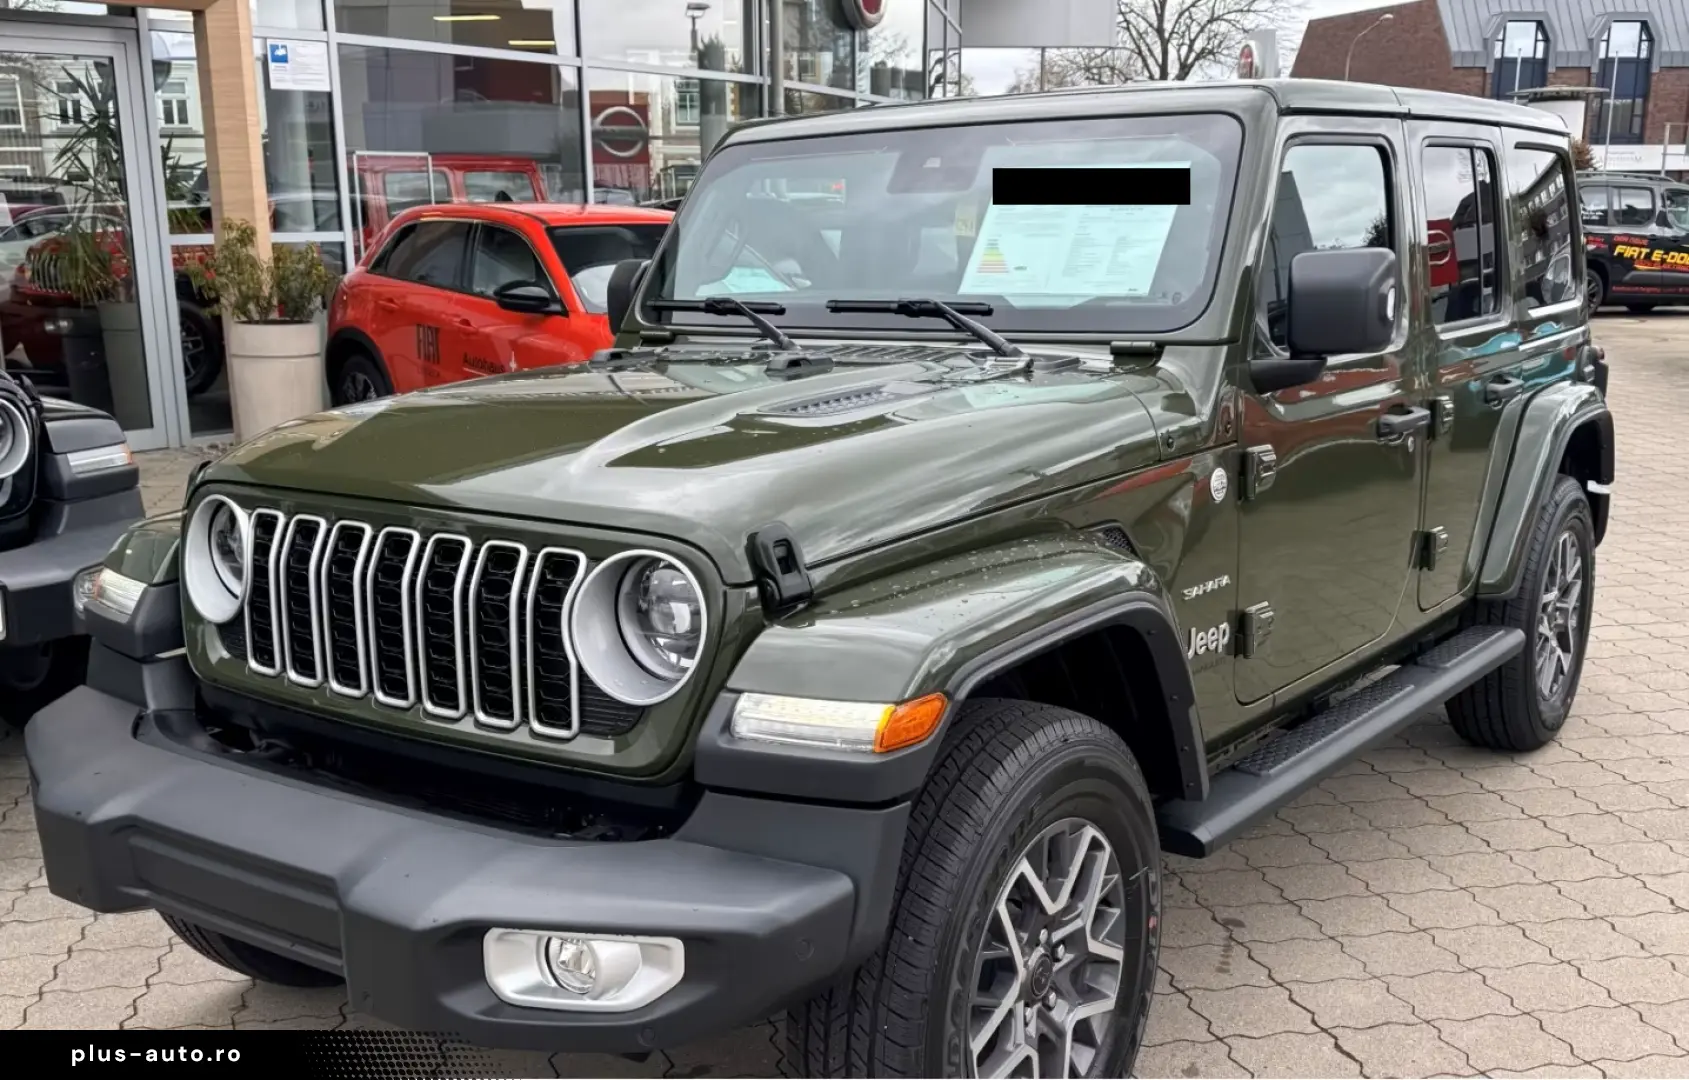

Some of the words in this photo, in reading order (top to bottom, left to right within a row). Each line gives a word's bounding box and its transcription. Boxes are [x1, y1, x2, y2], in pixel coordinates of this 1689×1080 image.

[1613, 244, 1650, 260] FIAT
[1651, 249, 1689, 265] E-DO
[416, 323, 441, 365] FIAT
[462, 351, 507, 375] Autohaus
[1182, 575, 1231, 600] SAHARA
[1187, 621, 1230, 660] Jeep
